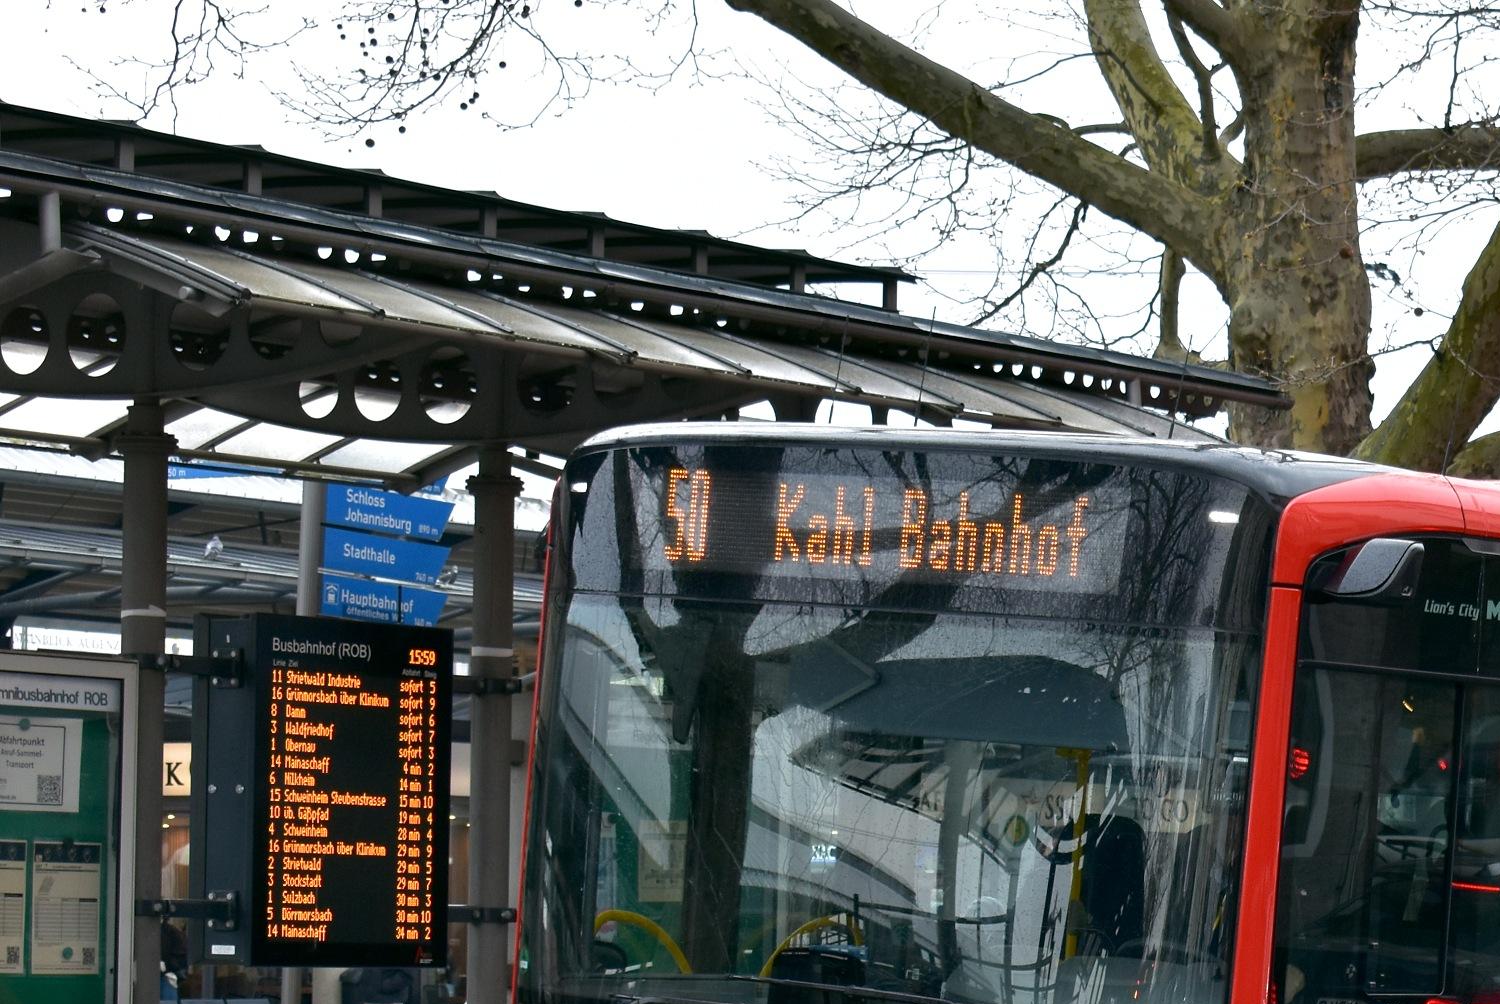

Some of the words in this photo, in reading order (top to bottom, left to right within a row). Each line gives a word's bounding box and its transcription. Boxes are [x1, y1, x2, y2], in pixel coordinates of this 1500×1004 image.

[346, 488, 386, 508] Schloss
[345, 508, 412, 534] Johannisburg
[431, 528, 439, 536] m
[664, 468, 712, 562] 50
[774, 482, 874, 567] Kahl
[900, 487, 1089, 578] Bahnhof
[343, 543, 396, 565] Stadthalle
[1424, 599, 1454, 615] Lion's
[1459, 603, 1480, 621] City
[272, 637, 337, 655] Busbahnhof
[338, 643, 372, 661] (ROB)
[409, 649, 436, 666] 15:59
[272, 670, 282, 683] 11
[286, 671, 325, 687] Strietwald
[327, 673, 361, 689] Industrie
[400, 680, 423, 694] sofort
[429, 681, 436, 695] 5
[84, 691, 108, 706] ROB
[272, 687, 282, 700] 16
[286, 689, 337, 704] Grünmorsbach
[340, 691, 356, 705] über
[359, 693, 389, 708] Klinikum
[400, 697, 423, 711] sofort
[429, 698, 436, 711] 9
[271, 704, 277, 717] 8
[285, 705, 307, 719] Damm
[400, 713, 423, 728] sofort
[428, 714, 435, 727] 6
[271, 720, 277, 734] 3
[285, 722, 335, 740] Waldfriedhof
[399, 730, 422, 744] sofort
[428, 731, 435, 744] 7
[271, 737, 276, 751] 1
[285, 738, 316, 753] Obernau
[398, 746, 422, 761] sofort
[428, 747, 435, 760] 3
[271, 755, 281, 768] 14
[284, 755, 331, 773] Mainaschaff
[403, 763, 409, 774] 4
[410, 763, 422, 776] min
[428, 763, 434, 776] 2
[269, 772, 276, 785] 6
[400, 778, 408, 791] 14
[410, 780, 422, 792] min
[428, 779, 433, 792] 1
[270, 789, 281, 802] 15
[284, 789, 329, 804] Schweinheim
[331, 791, 387, 806] Steubenstrasse
[399, 795, 408, 807] 15
[409, 796, 421, 808] min
[423, 796, 433, 809] 10
[270, 806, 281, 819] 10
[284, 807, 296, 820] üb.
[298, 807, 329, 823] Gäßpfad
[399, 811, 407, 824] 19
[409, 813, 421, 825] min
[426, 813, 433, 825] 4
[268, 823, 275, 835] 4
[283, 823, 328, 838] Schweinheim
[398, 828, 407, 841] 28
[408, 829, 420, 841] min
[426, 829, 433, 842] 4
[269, 840, 280, 853] 16
[283, 840, 334, 855] Grünmorsbach
[337, 842, 353, 855] über
[356, 843, 386, 857] Klinikum
[397, 844, 407, 857] 29
[408, 845, 420, 858] min
[426, 845, 432, 858] 9
[268, 858, 274, 870] 2
[282, 857, 322, 871] Strietwald
[397, 861, 406, 874] 29
[407, 862, 420, 874] min
[426, 862, 432, 875] 5
[268, 873, 274, 887] 3
[282, 874, 322, 888] Stockstadt
[396, 877, 406, 890] 29
[407, 878, 420, 890] min
[426, 878, 432, 891] 7
[268, 891, 273, 903] 1
[282, 891, 316, 905] Sulzbach
[396, 894, 406, 907] 30
[407, 894, 419, 907] min
[425, 894, 432, 907] 3
[267, 907, 274, 920] 5
[281, 907, 333, 922] Dörrmorsbach
[396, 911, 405, 923] 30
[406, 911, 419, 923] min
[420, 911, 431, 923] 10
[267, 924, 278, 937] 14
[281, 925, 327, 941] Mainaschaff
[395, 928, 405, 940] 34
[406, 928, 418, 940] min
[424, 927, 431, 940] 2
